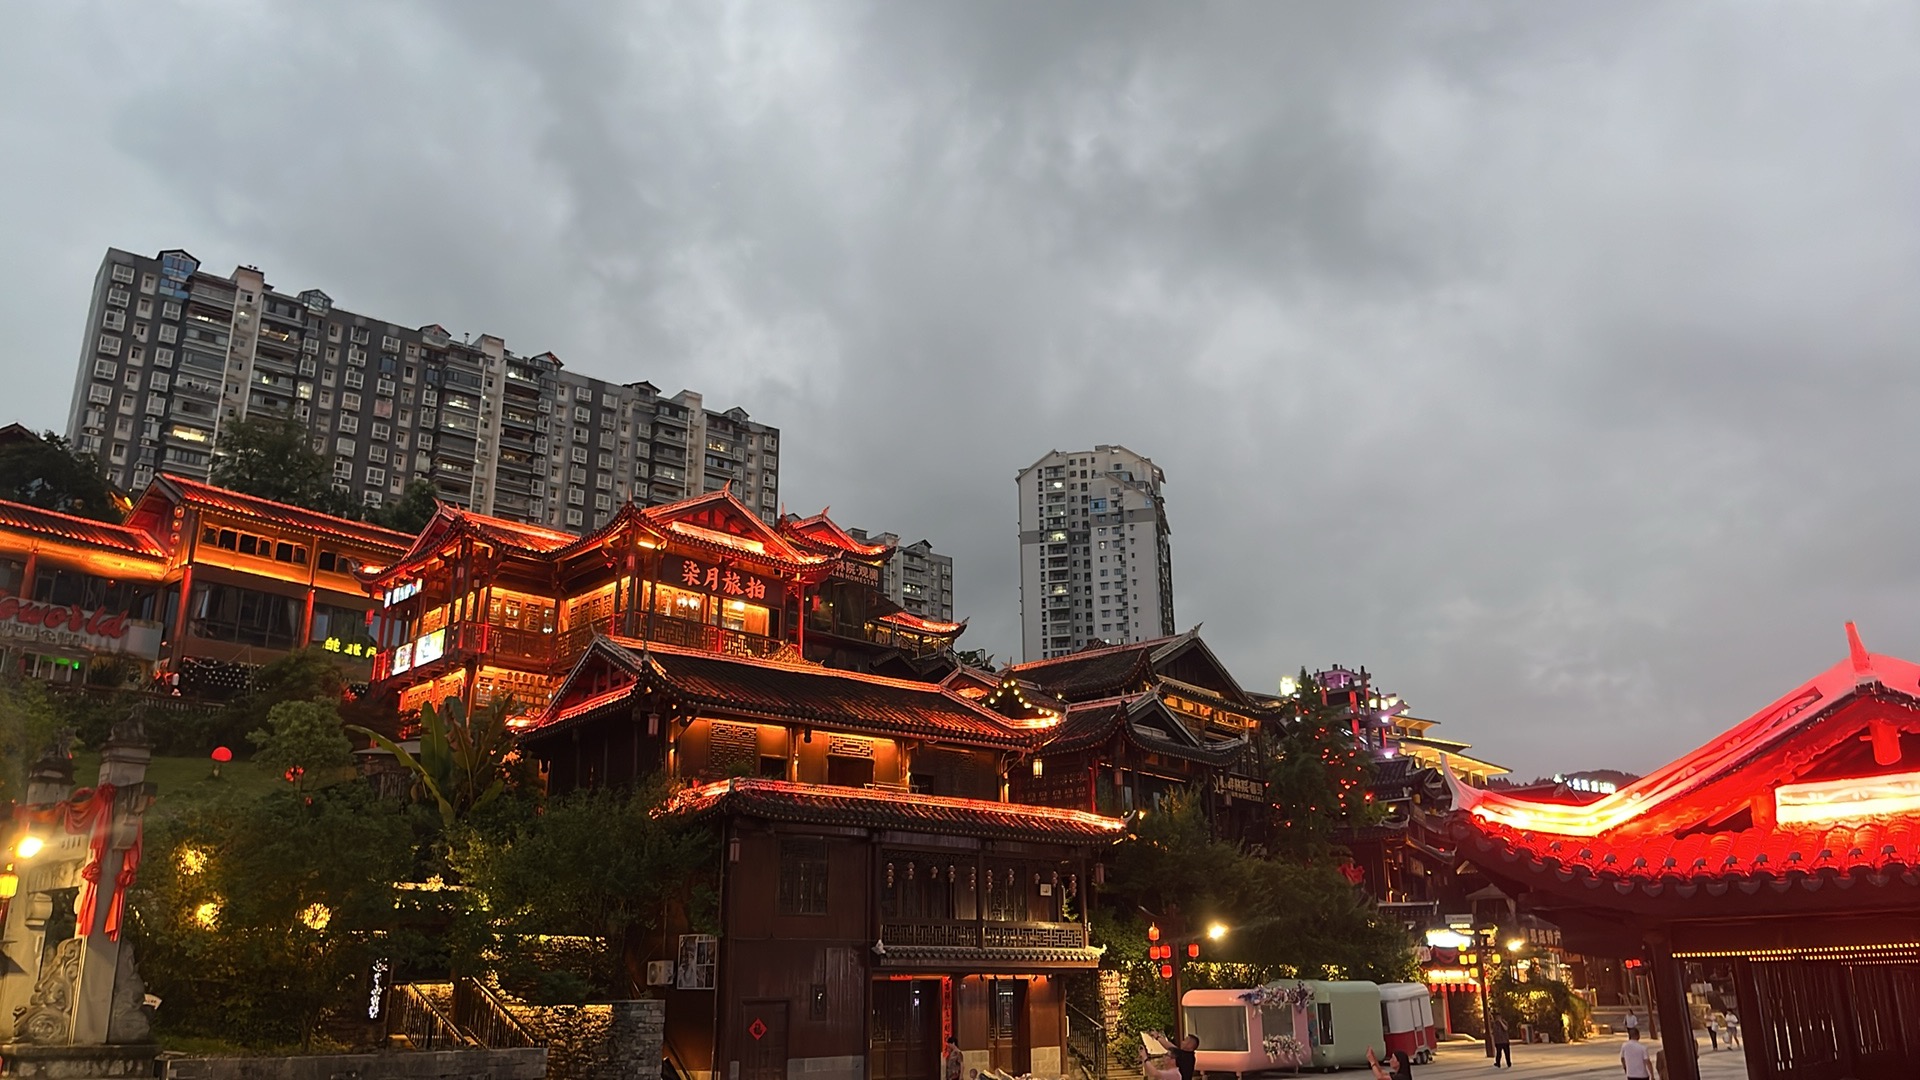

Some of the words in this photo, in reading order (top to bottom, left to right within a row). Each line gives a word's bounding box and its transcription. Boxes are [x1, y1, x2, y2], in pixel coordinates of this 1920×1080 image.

[682, 560, 766, 599] 柒月旅拍
[845, 574, 879, 587] HOMESTAY
